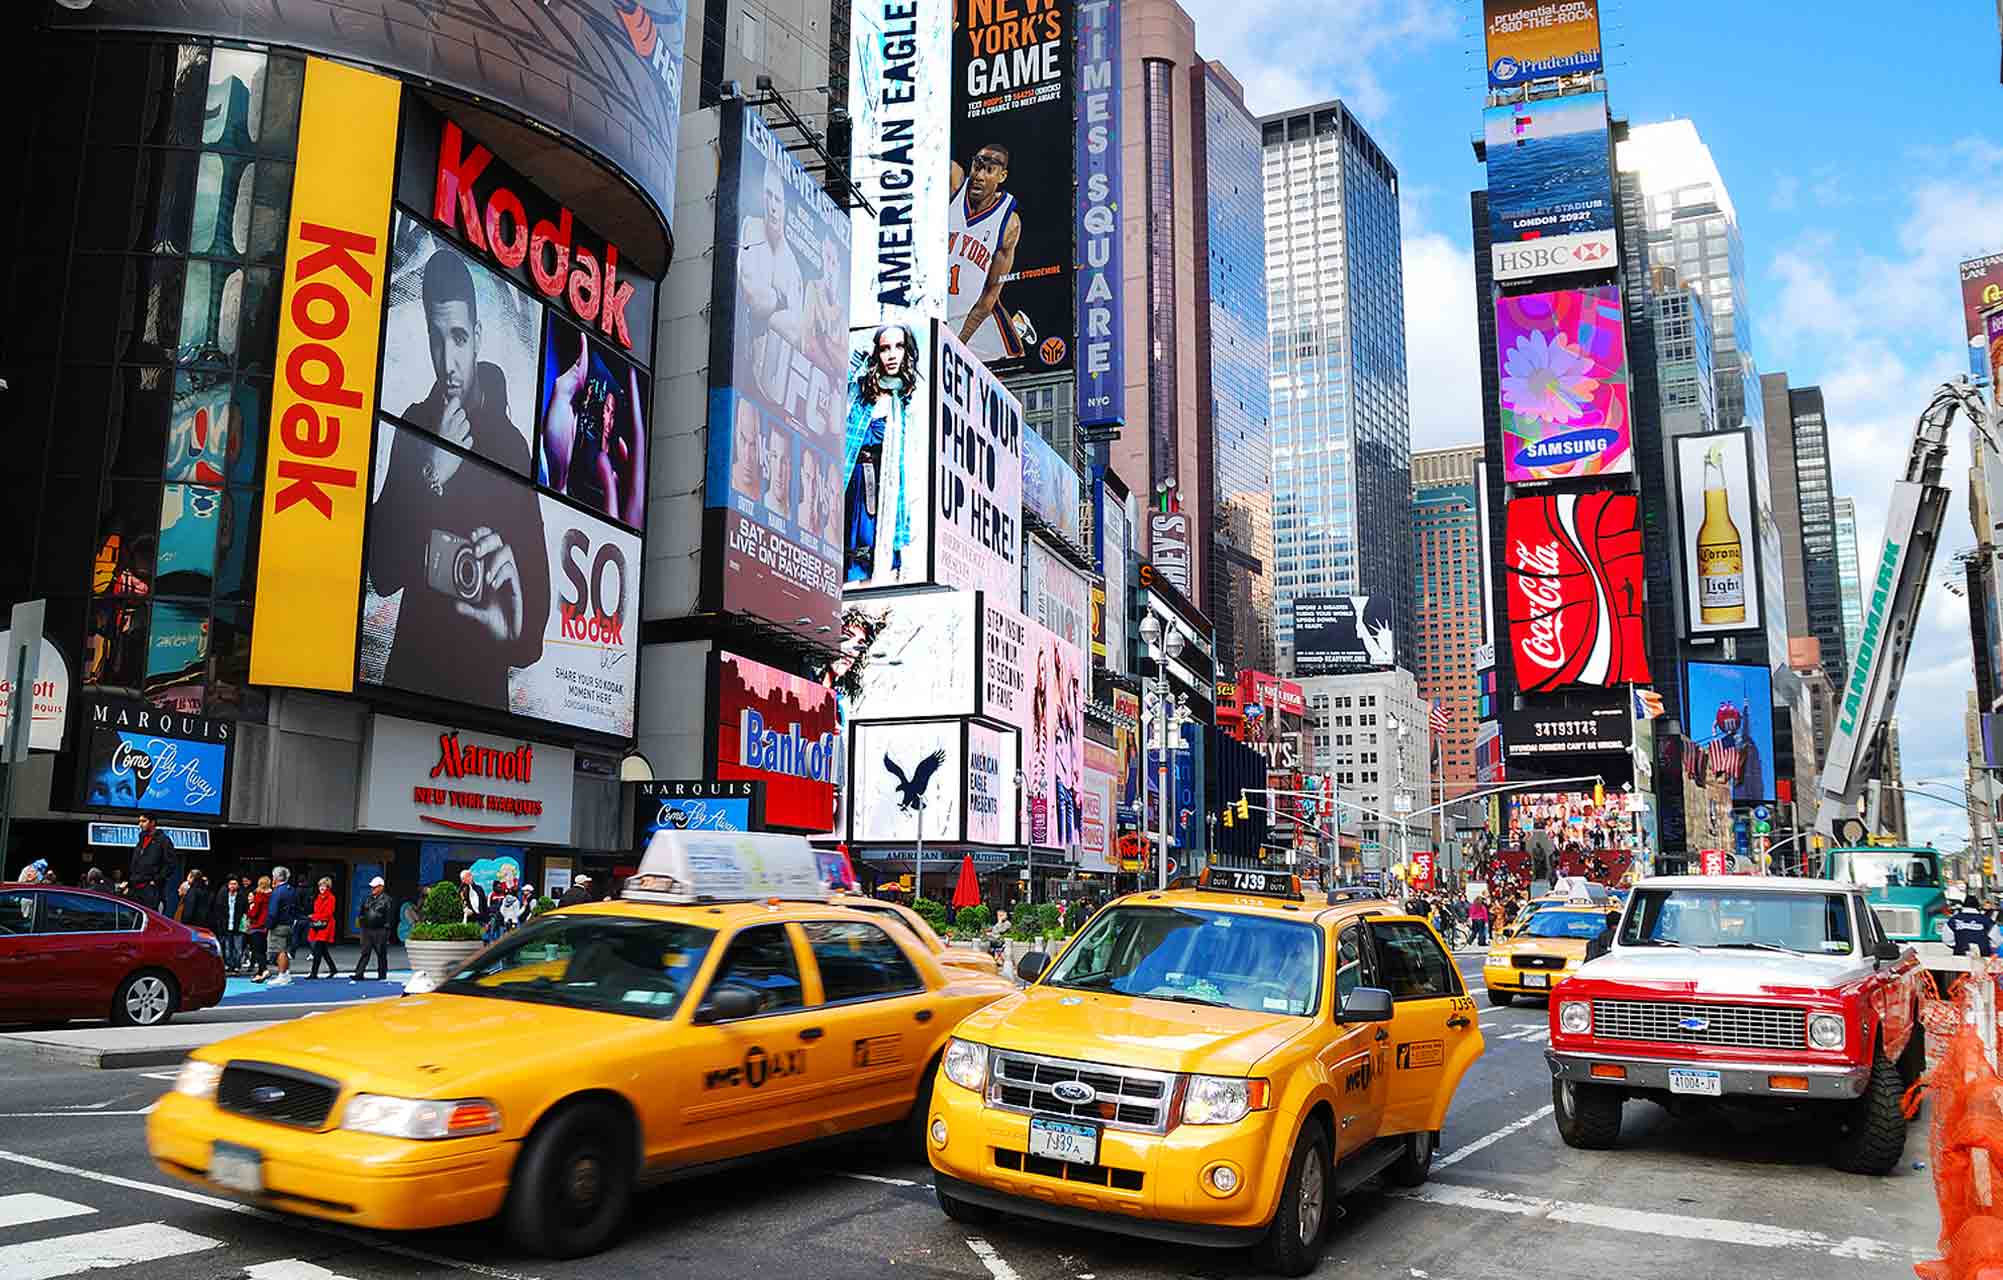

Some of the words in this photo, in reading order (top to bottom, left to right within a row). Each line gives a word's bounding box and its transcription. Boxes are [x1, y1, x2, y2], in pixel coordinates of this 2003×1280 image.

[1489, 8, 1594, 35] 1-800-THE-ROCK
[1495, 1, 1585, 26] prudential.com
[968, 10, 1062, 58] YORK'S
[882, 0, 917, 105] EAGLE
[967, 40, 1062, 97] GAME
[1520, 50, 1598, 73] Prudential
[1081, 2, 1112, 154] TIMES
[968, 109, 980, 118] FOR
[987, 103, 1010, 114] CHANCE
[877, 119, 915, 308] AMERICAN
[1513, 216, 1557, 229] LONDON
[1554, 200, 1603, 213] STADIUM
[433, 118, 634, 350] Kodak
[959, 233, 992, 273] YORK
[1500, 246, 1569, 272] HSBC
[1083, 173, 1115, 375] SQUARE
[274, 221, 377, 521] Kodak
[752, 326, 831, 434] UFC
[942, 344, 975, 413] GET
[980, 381, 1019, 458] YOUR
[1088, 395, 1110, 408] NYC
[942, 402, 995, 492] PHOTO
[1527, 438, 1607, 457] SAMSUNG
[942, 465, 965, 526] UP
[971, 487, 1014, 564] HERE!
[730, 531, 756, 557] LIVE
[759, 547, 776, 568] ON
[740, 518, 767, 547] SAT.
[770, 535, 822, 575] OCTOBER
[560, 528, 625, 620] SO
[1705, 578, 1739, 594] Light
[1516, 540, 1566, 669] Coca-Cola
[560, 602, 624, 646] Kodak
[987, 608, 1003, 633] STEP
[1005, 617, 1024, 646] INSIDE
[1839, 537, 1900, 737] LANDMARK
[987, 632, 1000, 657] FOR
[1001, 638, 1018, 667] YOUR
[555, 667, 577, 683] SHARE
[578, 674, 594, 687] YOUR
[595, 678, 603, 689] SO
[603, 680, 625, 697] KODAK
[988, 657, 996, 679] 15
[997, 662, 1025, 692] SECONDS
[568, 684, 596, 701] MOMENT
[596, 692, 612, 705] HERE
[987, 682, 995, 704] OF
[93, 704, 229, 739] MARQUIS
[430, 733, 534, 784] Marriott
[740, 706, 808, 778] Bank
[808, 731, 834, 784] of
[1567, 742, 1586, 750] CAN'T
[112, 740, 151, 775] Come
[138, 739, 178, 784] Fly
[175, 758, 217, 806] Away
[970, 752, 998, 775] AMERICAN
[642, 783, 752, 795] MARQUIS
[970, 773, 987, 792] EAGLE
[414, 786, 447, 806] NEW
[449, 791, 485, 809] YORK
[486, 795, 543, 816] MARQUIS
[657, 803, 687, 828] Come
[675, 800, 707, 829] Fly
[970, 794, 998, 814] PRESENTS
[1213, 878, 1228, 886] DUTY
[1233, 872, 1266, 890] 7J39
[1269, 883, 1285, 891] DUTY
[1449, 997, 1476, 1012] 7J39
[1059, 1086, 1083, 1098] Ford
